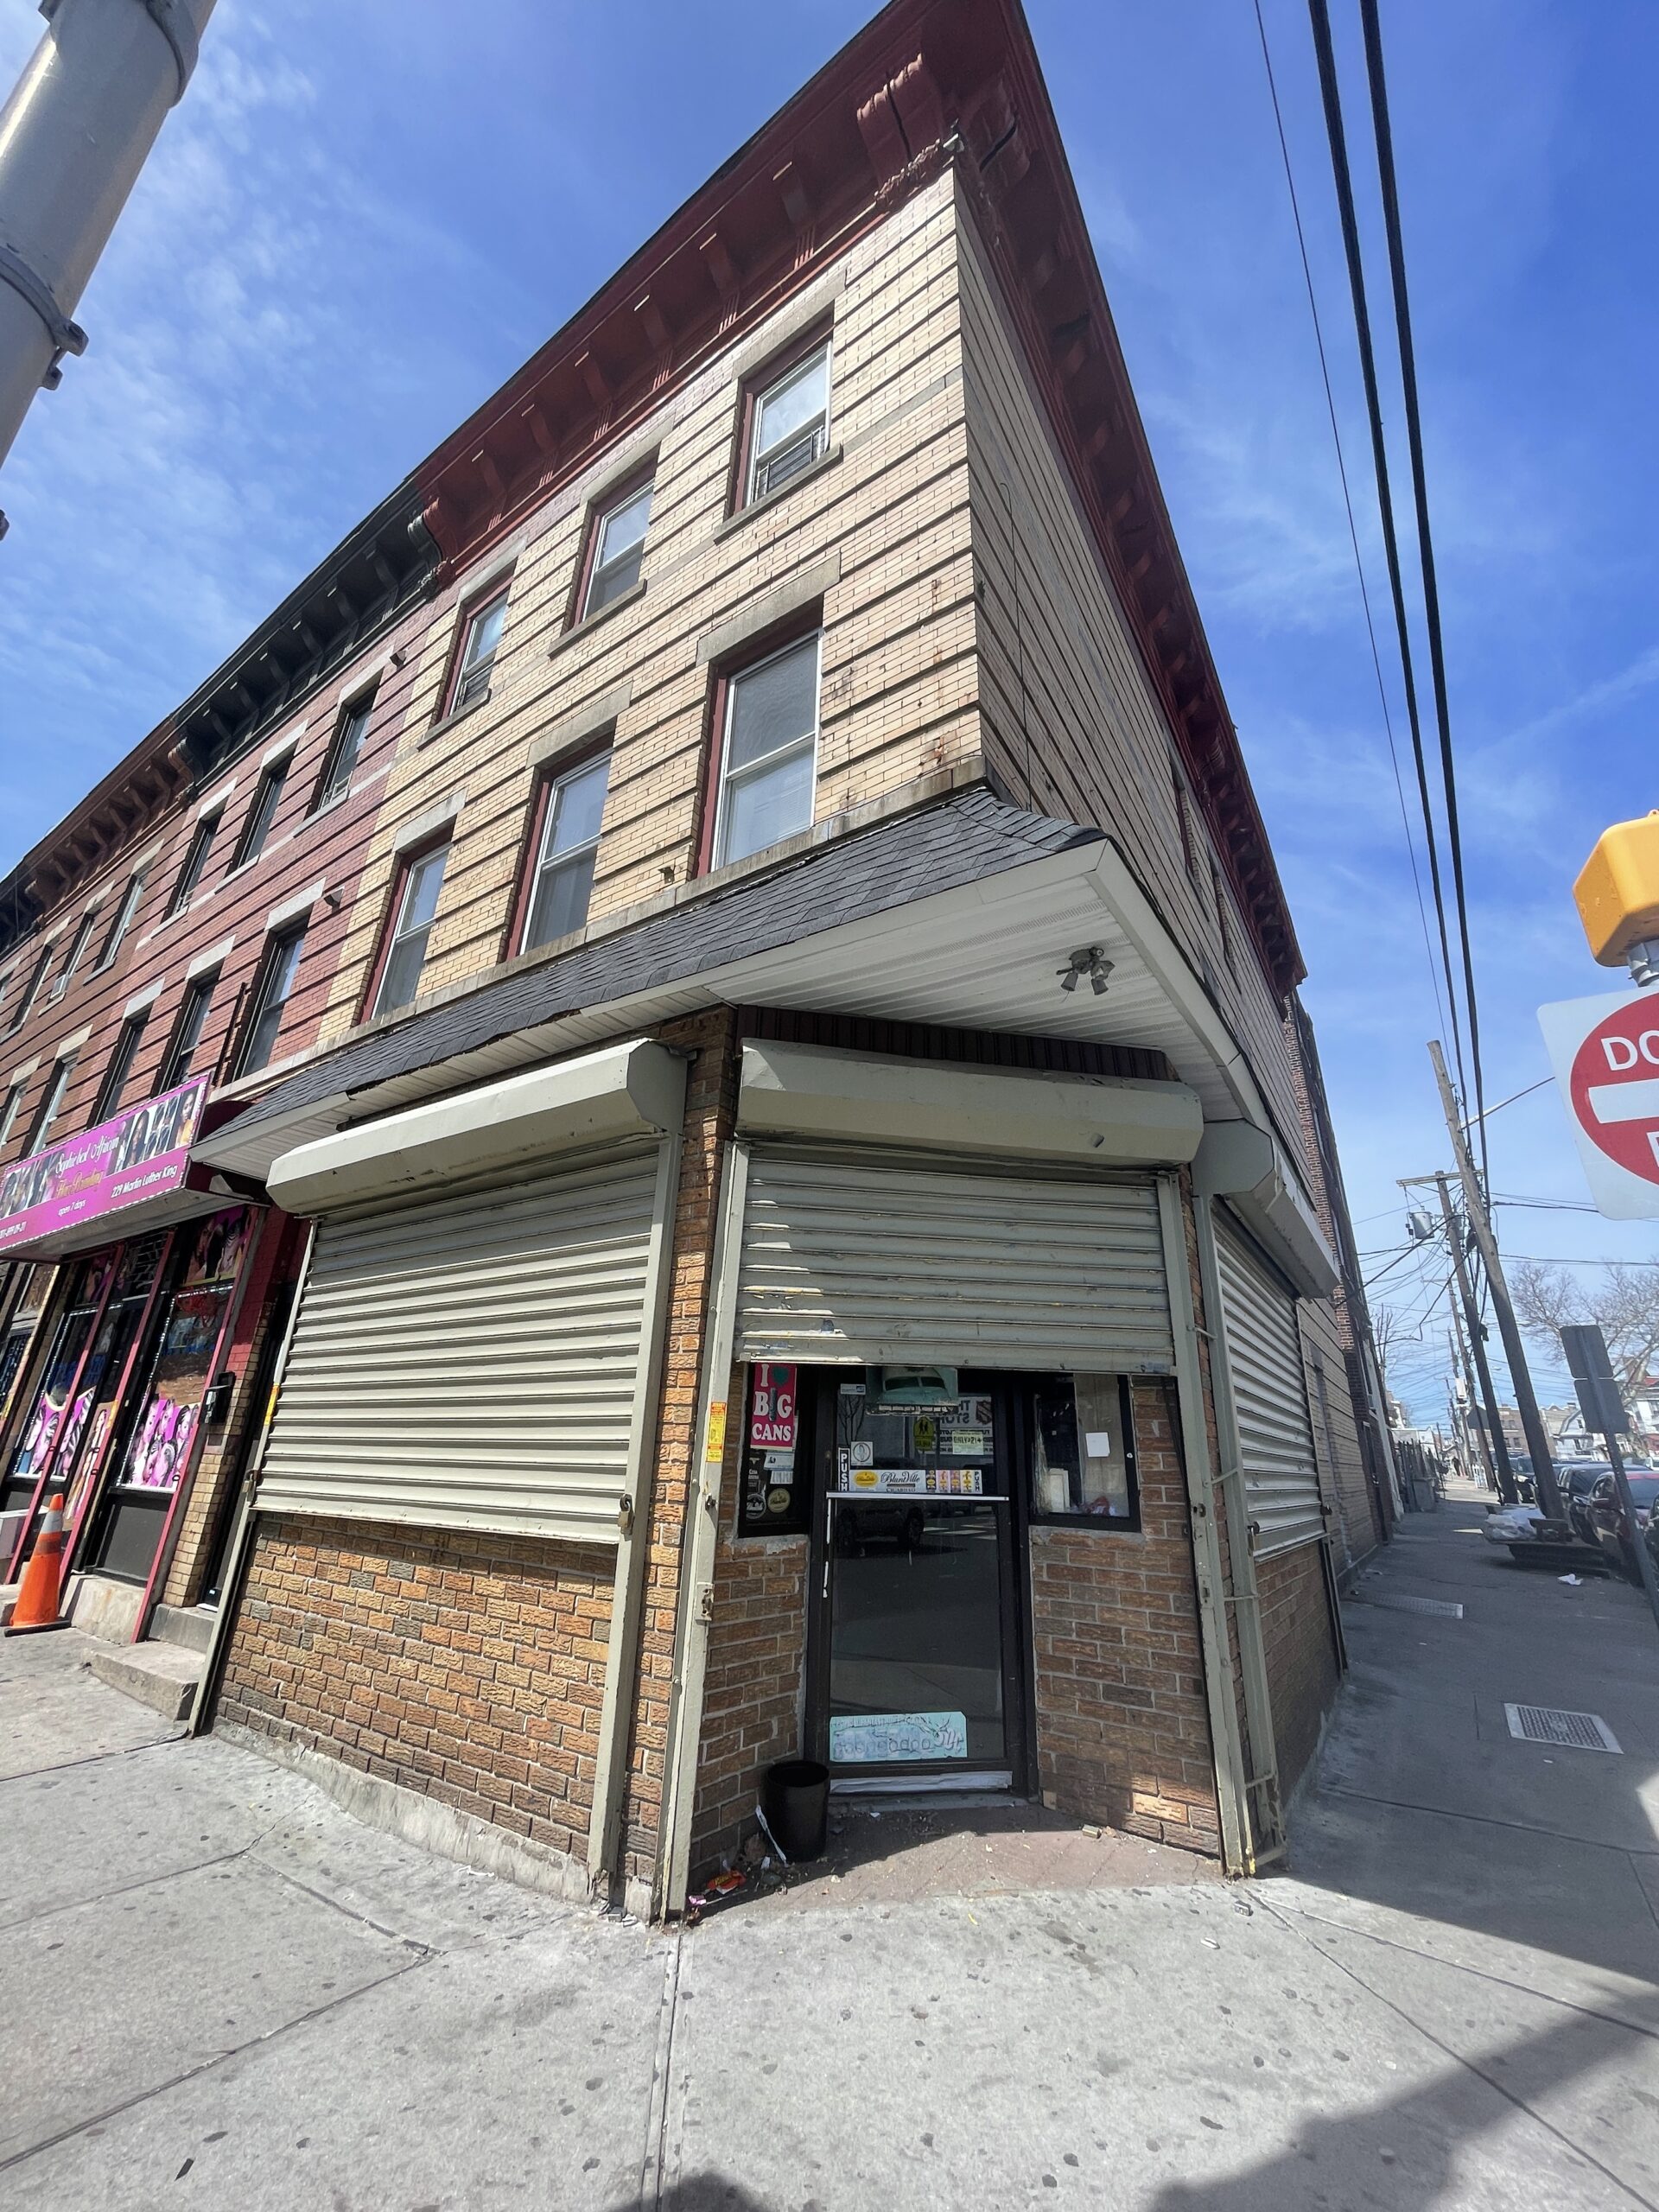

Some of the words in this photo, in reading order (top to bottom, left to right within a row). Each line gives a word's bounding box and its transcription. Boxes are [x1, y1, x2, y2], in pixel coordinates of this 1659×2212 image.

[122, 1177, 143, 1193] Martin
[142, 1171, 162, 1186] Luther
[162, 1165, 178, 1179] King
[760, 1363, 769, 1387] I
[752, 1423, 791, 1441] CANS
